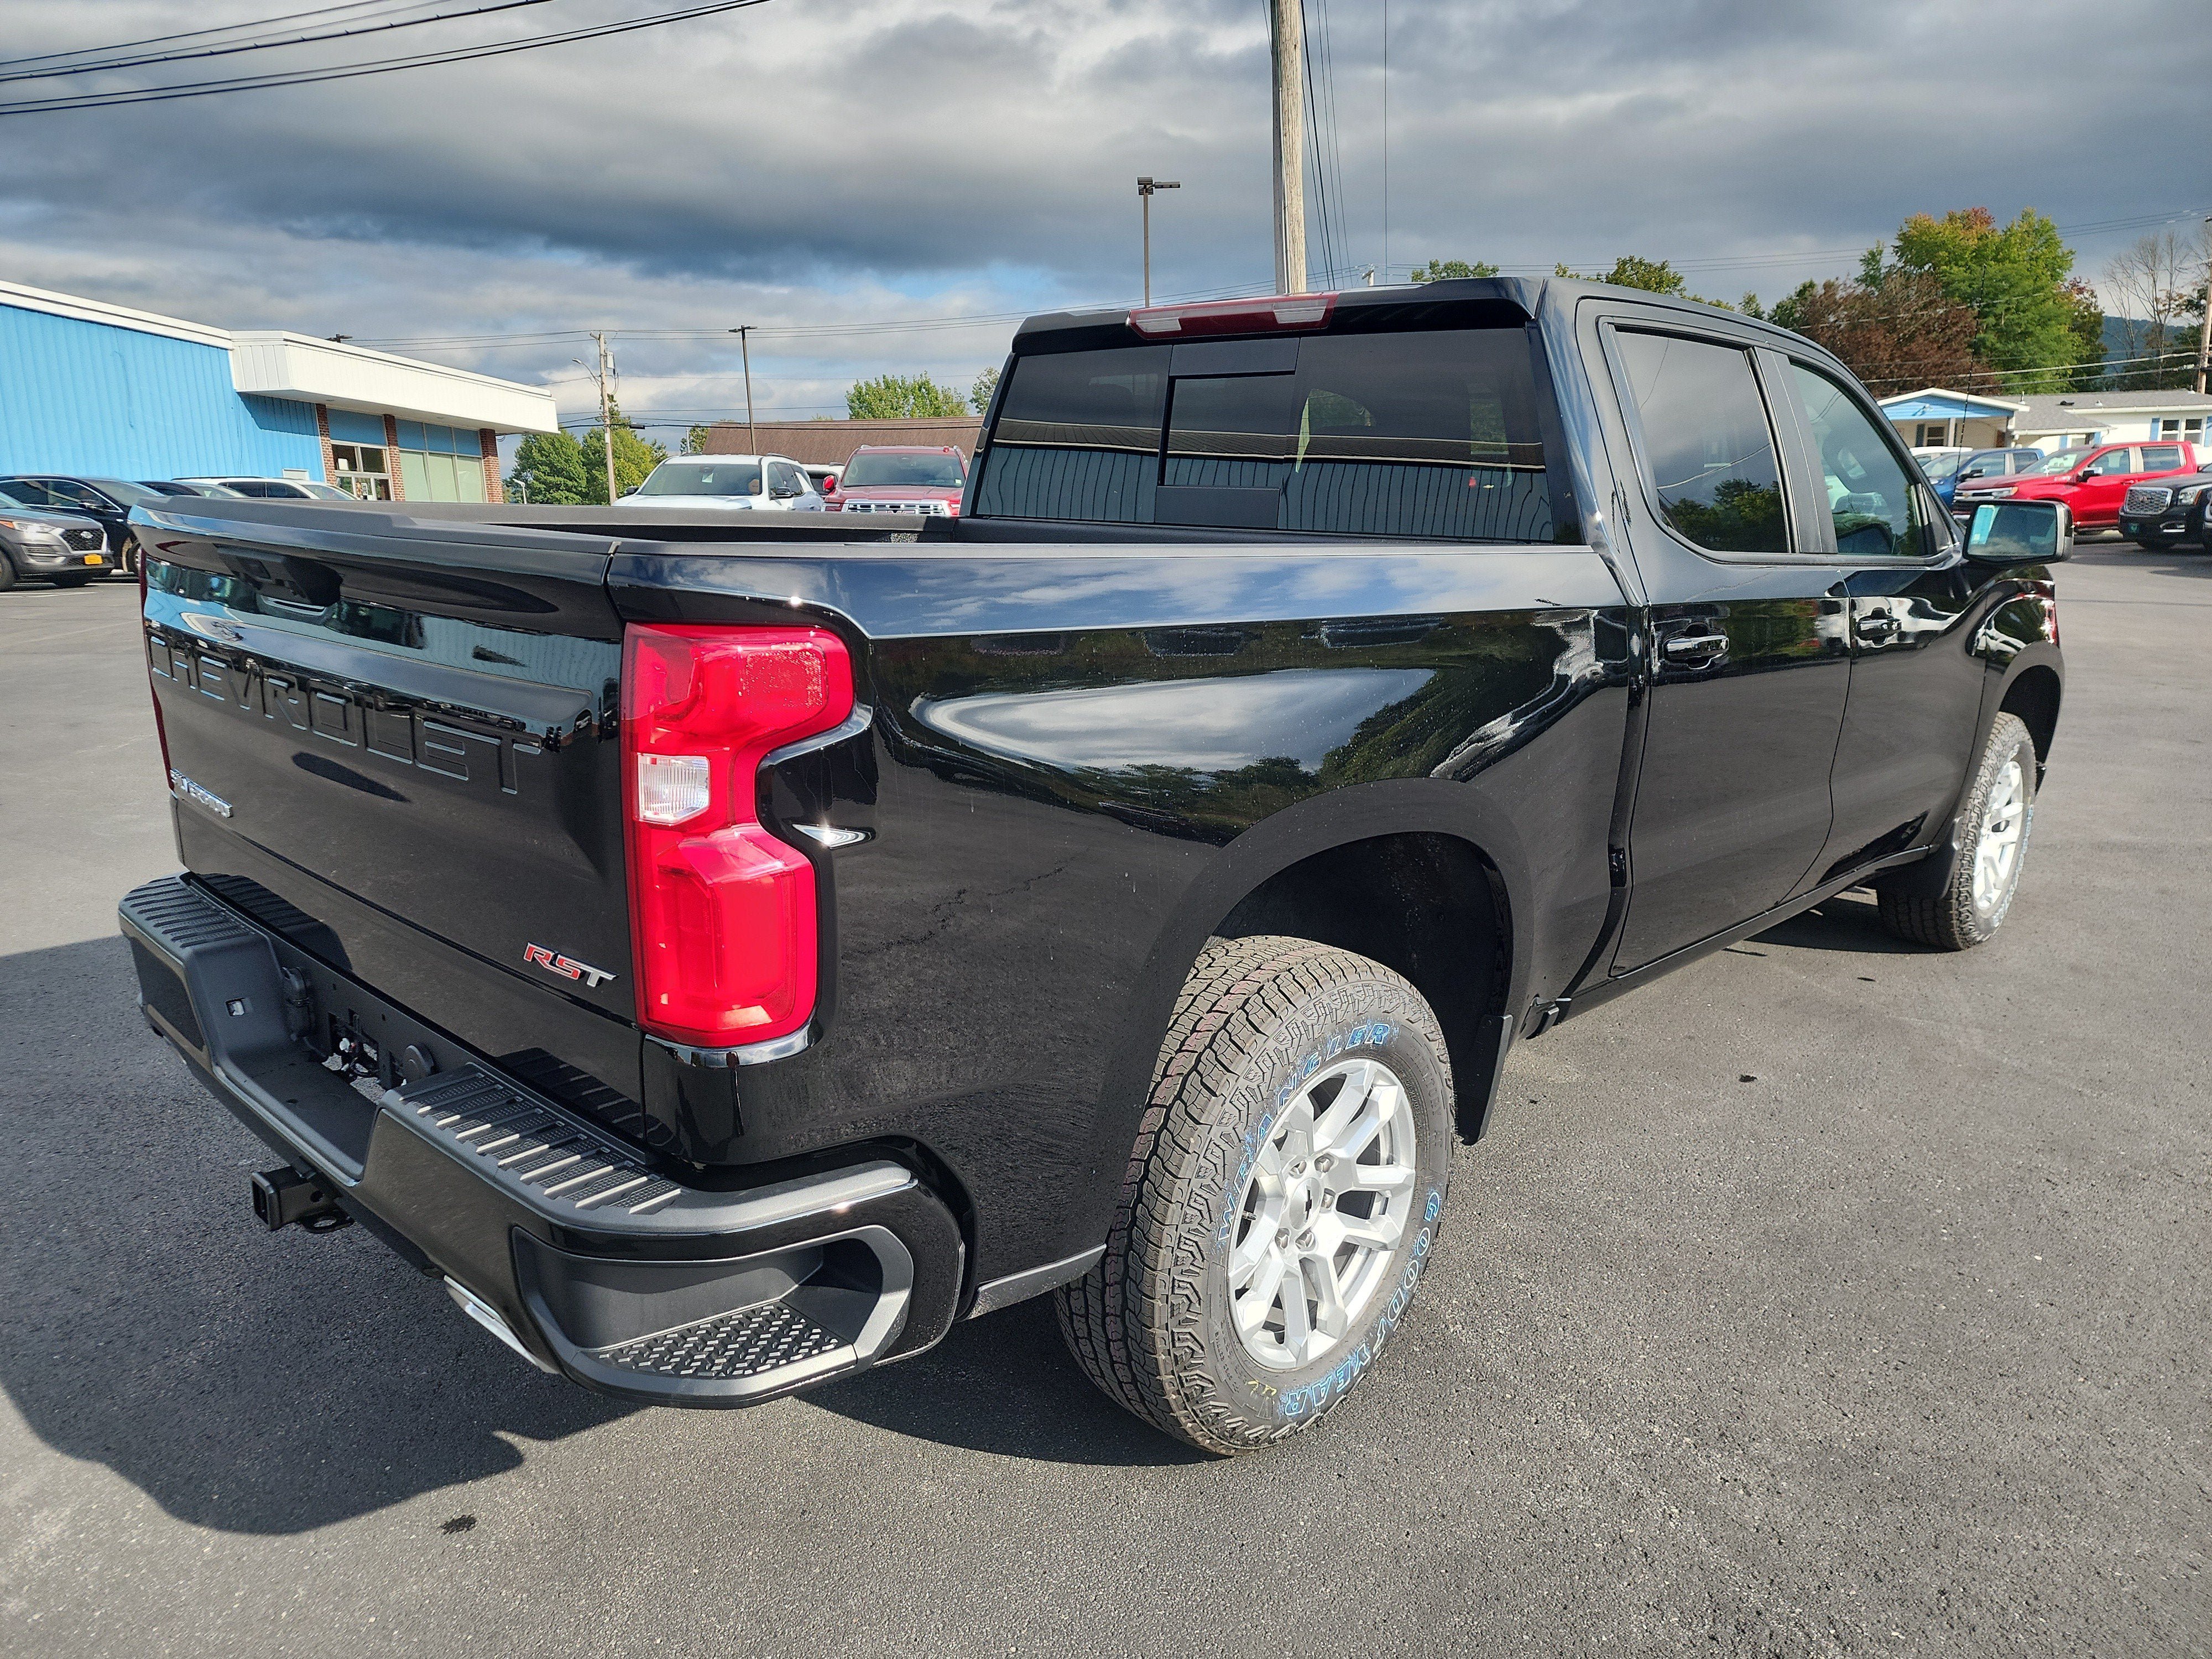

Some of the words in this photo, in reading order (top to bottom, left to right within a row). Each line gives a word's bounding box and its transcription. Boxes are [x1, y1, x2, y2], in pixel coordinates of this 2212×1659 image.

[147, 629, 542, 795] CHEVROLET
[524, 942, 618, 988] RST
[1217, 1023, 1390, 1241] WRANGLER
[1284, 1192, 1441, 1416] GOODYEAR
